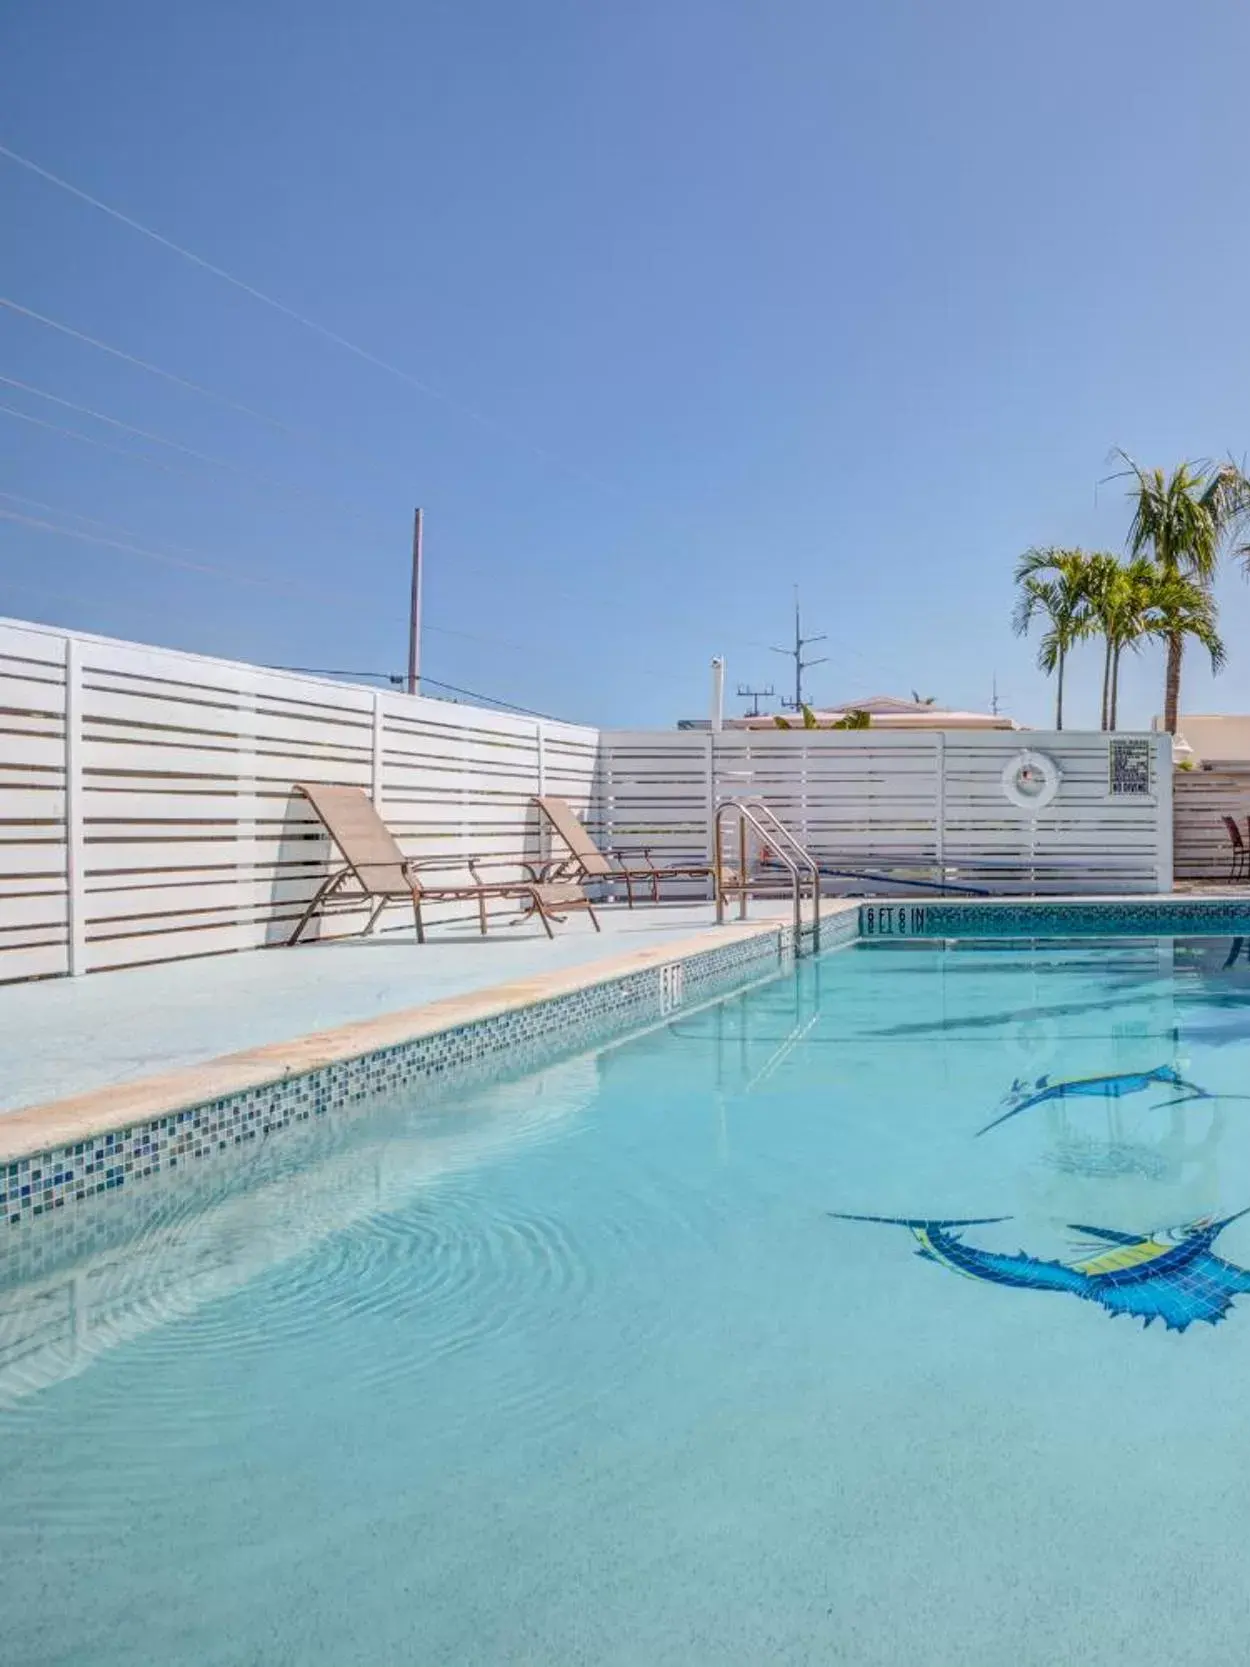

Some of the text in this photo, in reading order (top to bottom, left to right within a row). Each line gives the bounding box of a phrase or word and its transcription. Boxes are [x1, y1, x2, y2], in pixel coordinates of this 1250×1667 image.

[1113, 783, 1147, 793] NO DIVING
[867, 907, 924, 922] 6 FT 6 IN
